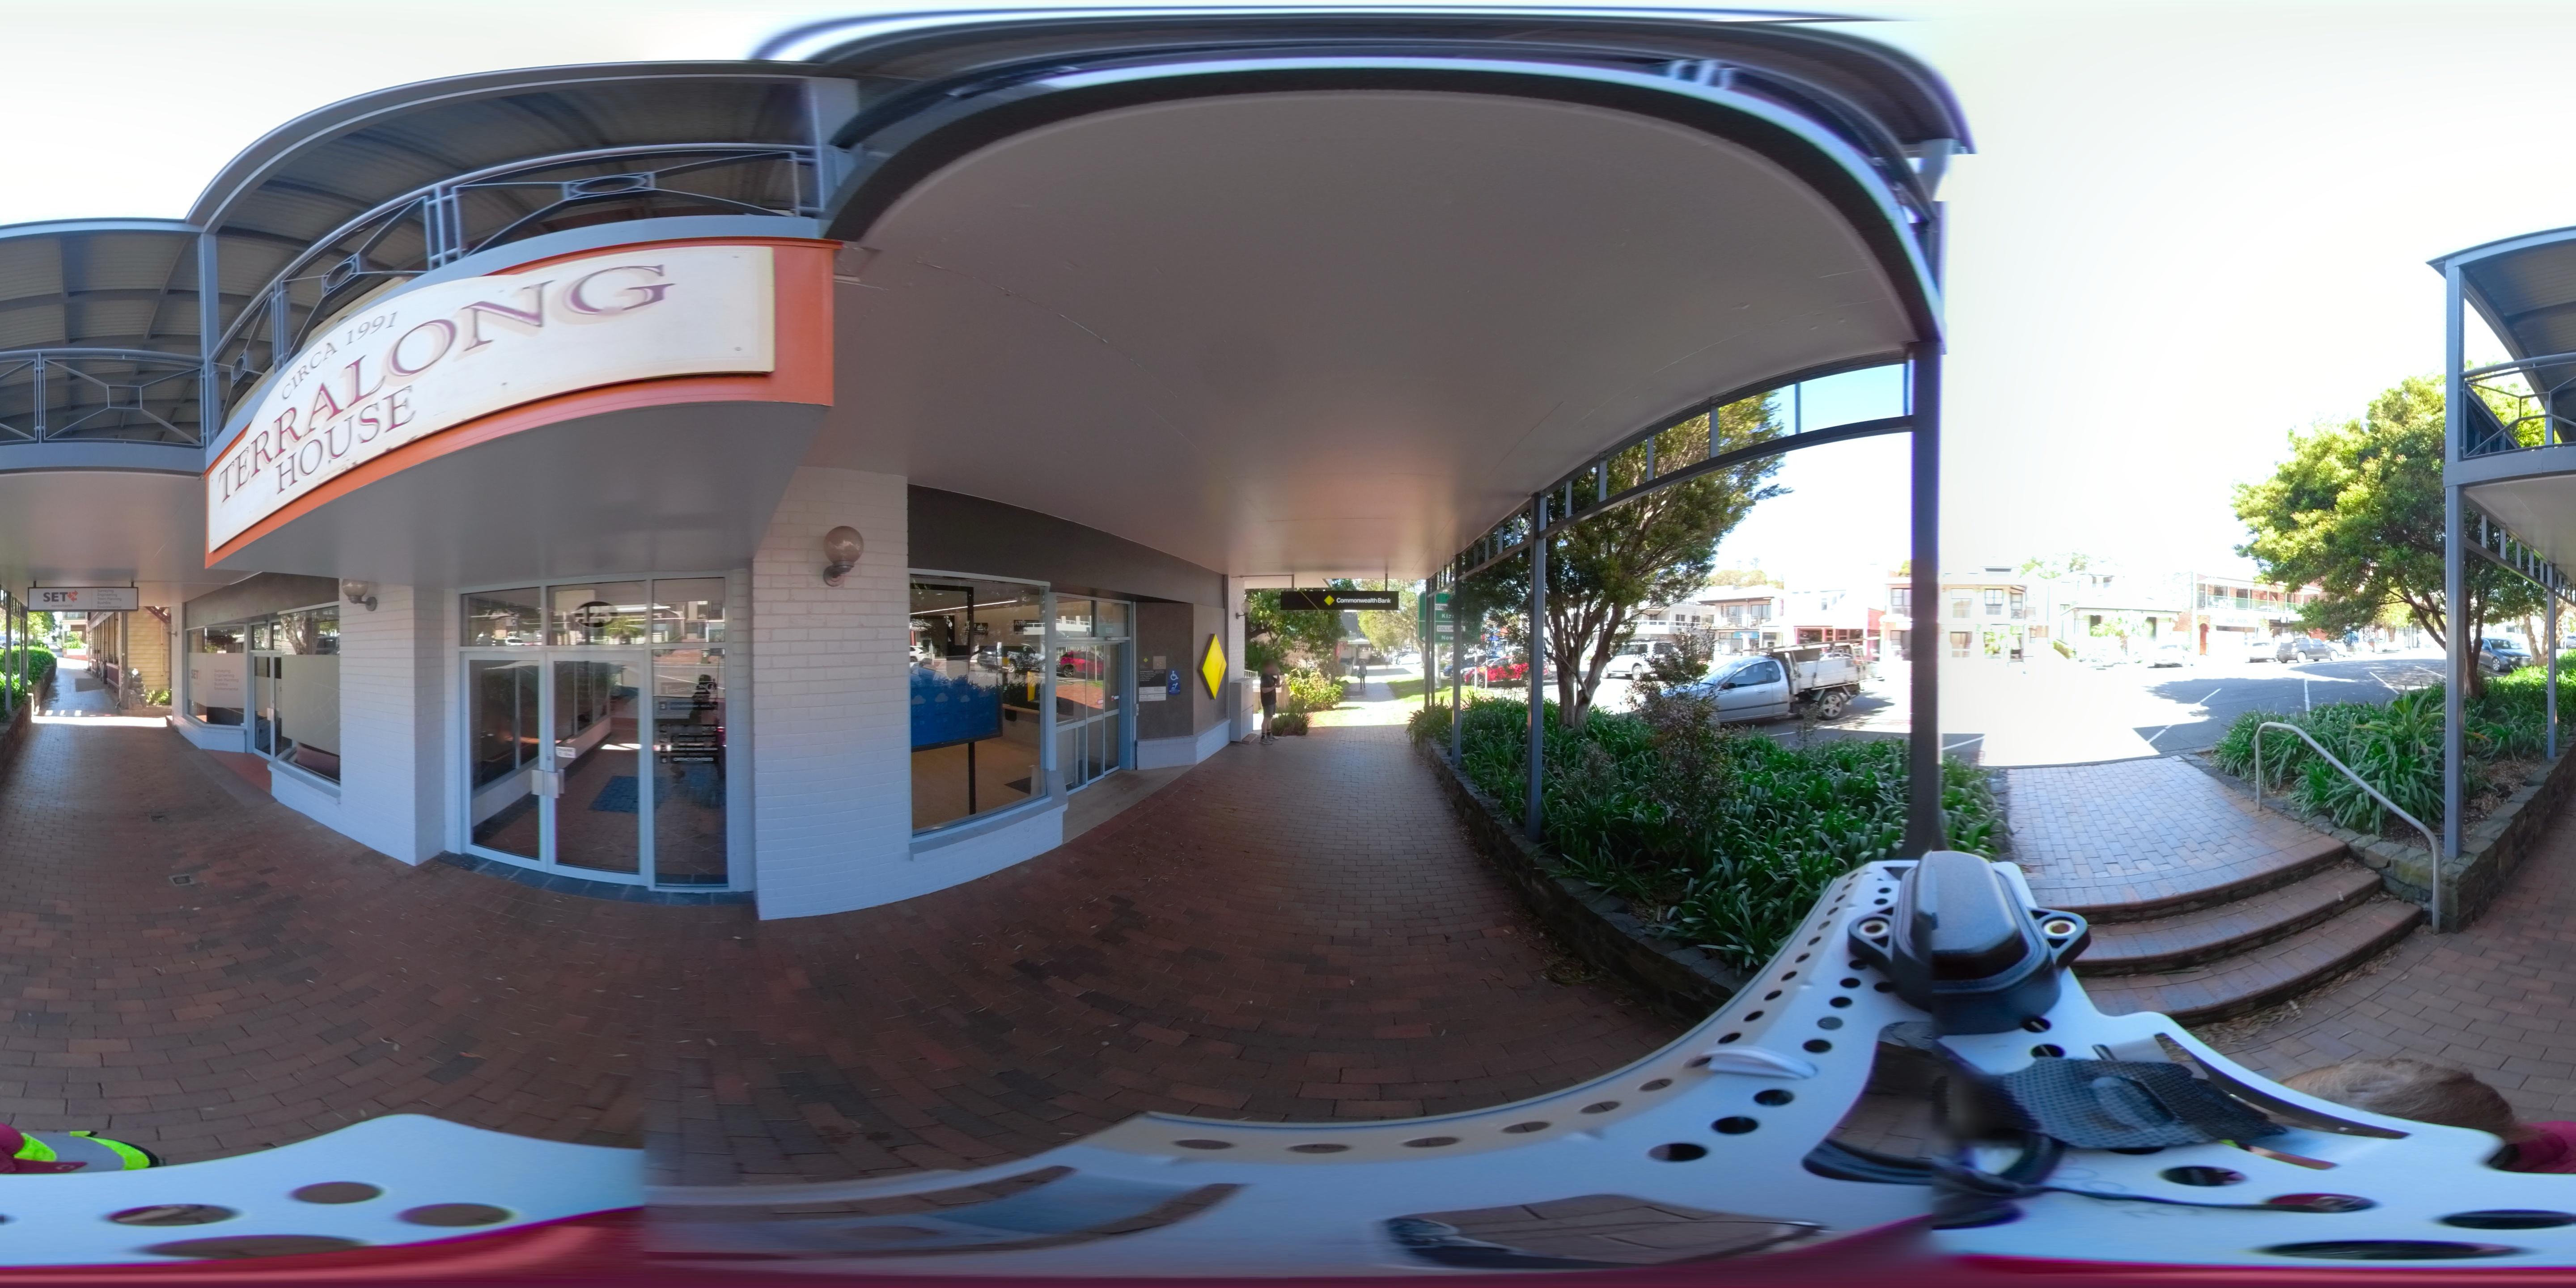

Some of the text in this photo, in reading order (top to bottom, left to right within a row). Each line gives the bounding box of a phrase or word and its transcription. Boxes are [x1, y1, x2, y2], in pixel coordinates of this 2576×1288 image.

[218, 264, 676, 504] TERRALONG
[282, 311, 398, 401] CIRCA 1991
[275, 385, 416, 495] HOUSE
[43, 592, 68, 602] SET
